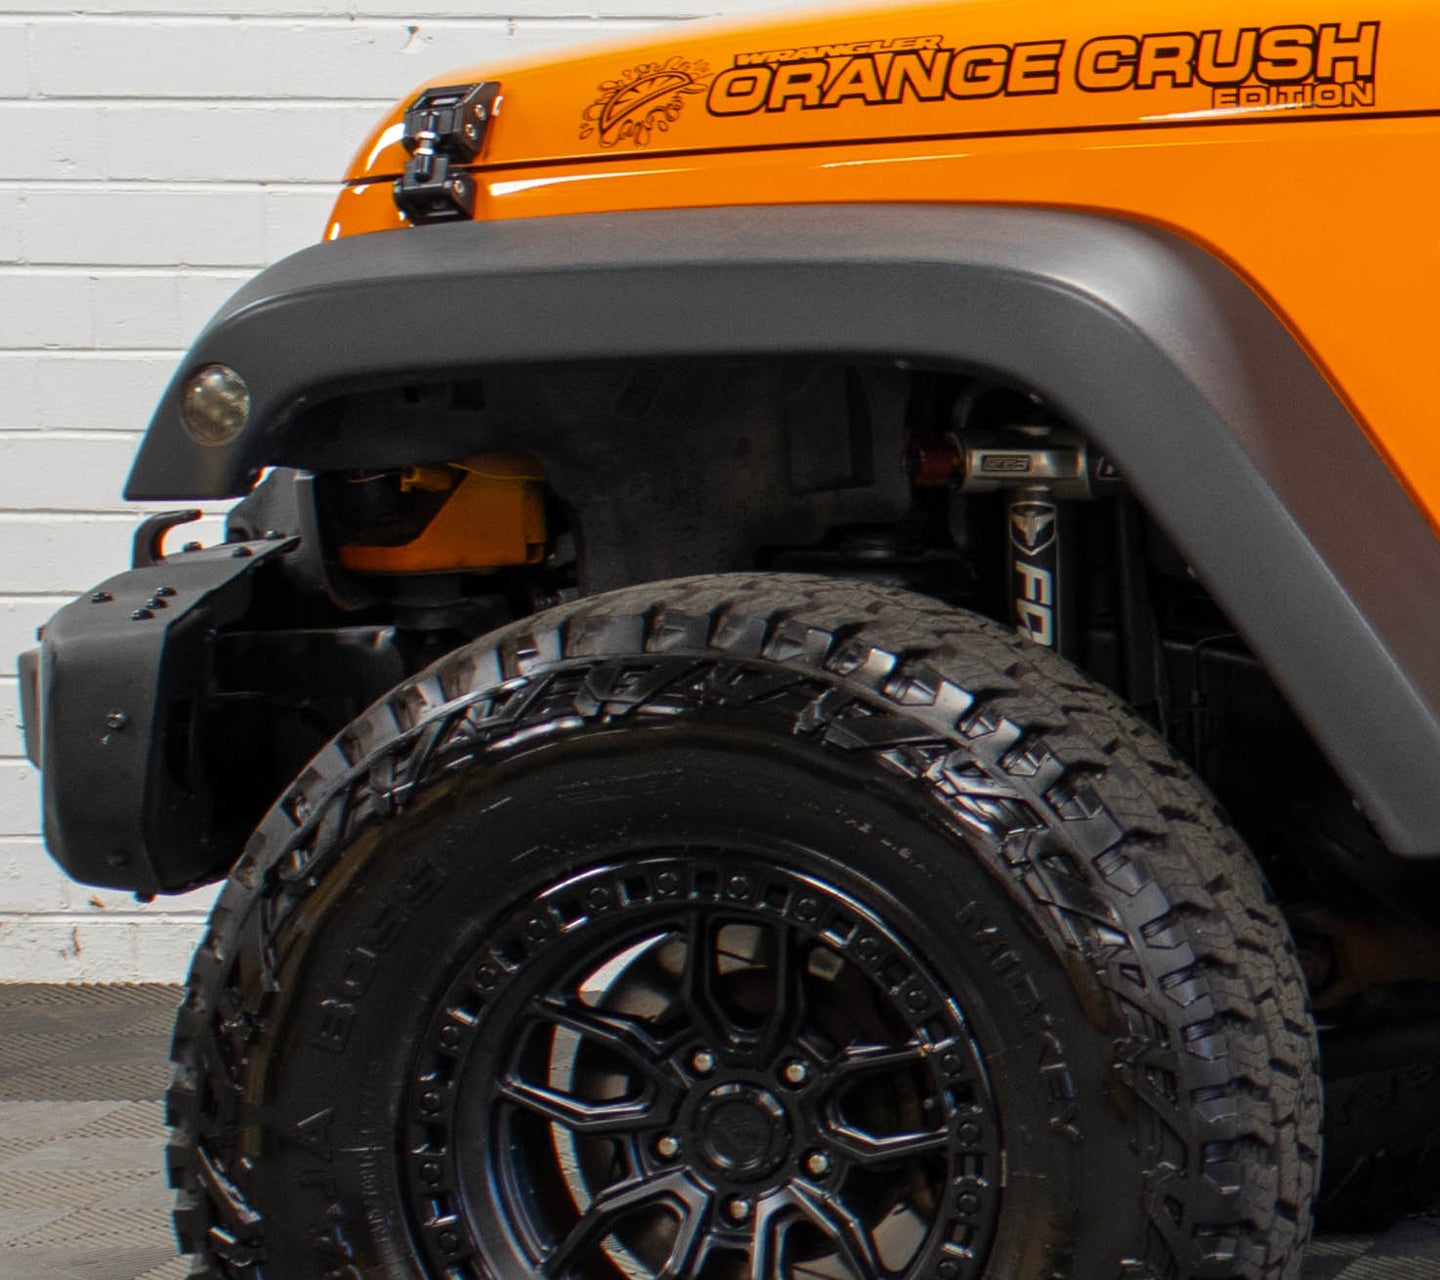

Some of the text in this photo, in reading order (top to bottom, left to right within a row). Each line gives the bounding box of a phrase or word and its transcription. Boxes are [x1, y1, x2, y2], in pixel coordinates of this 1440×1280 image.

[734, 34, 943, 65] WRANGLER
[706, 20, 1382, 118] ORANGE CRUSH
[1212, 80, 1376, 112] EDITION
